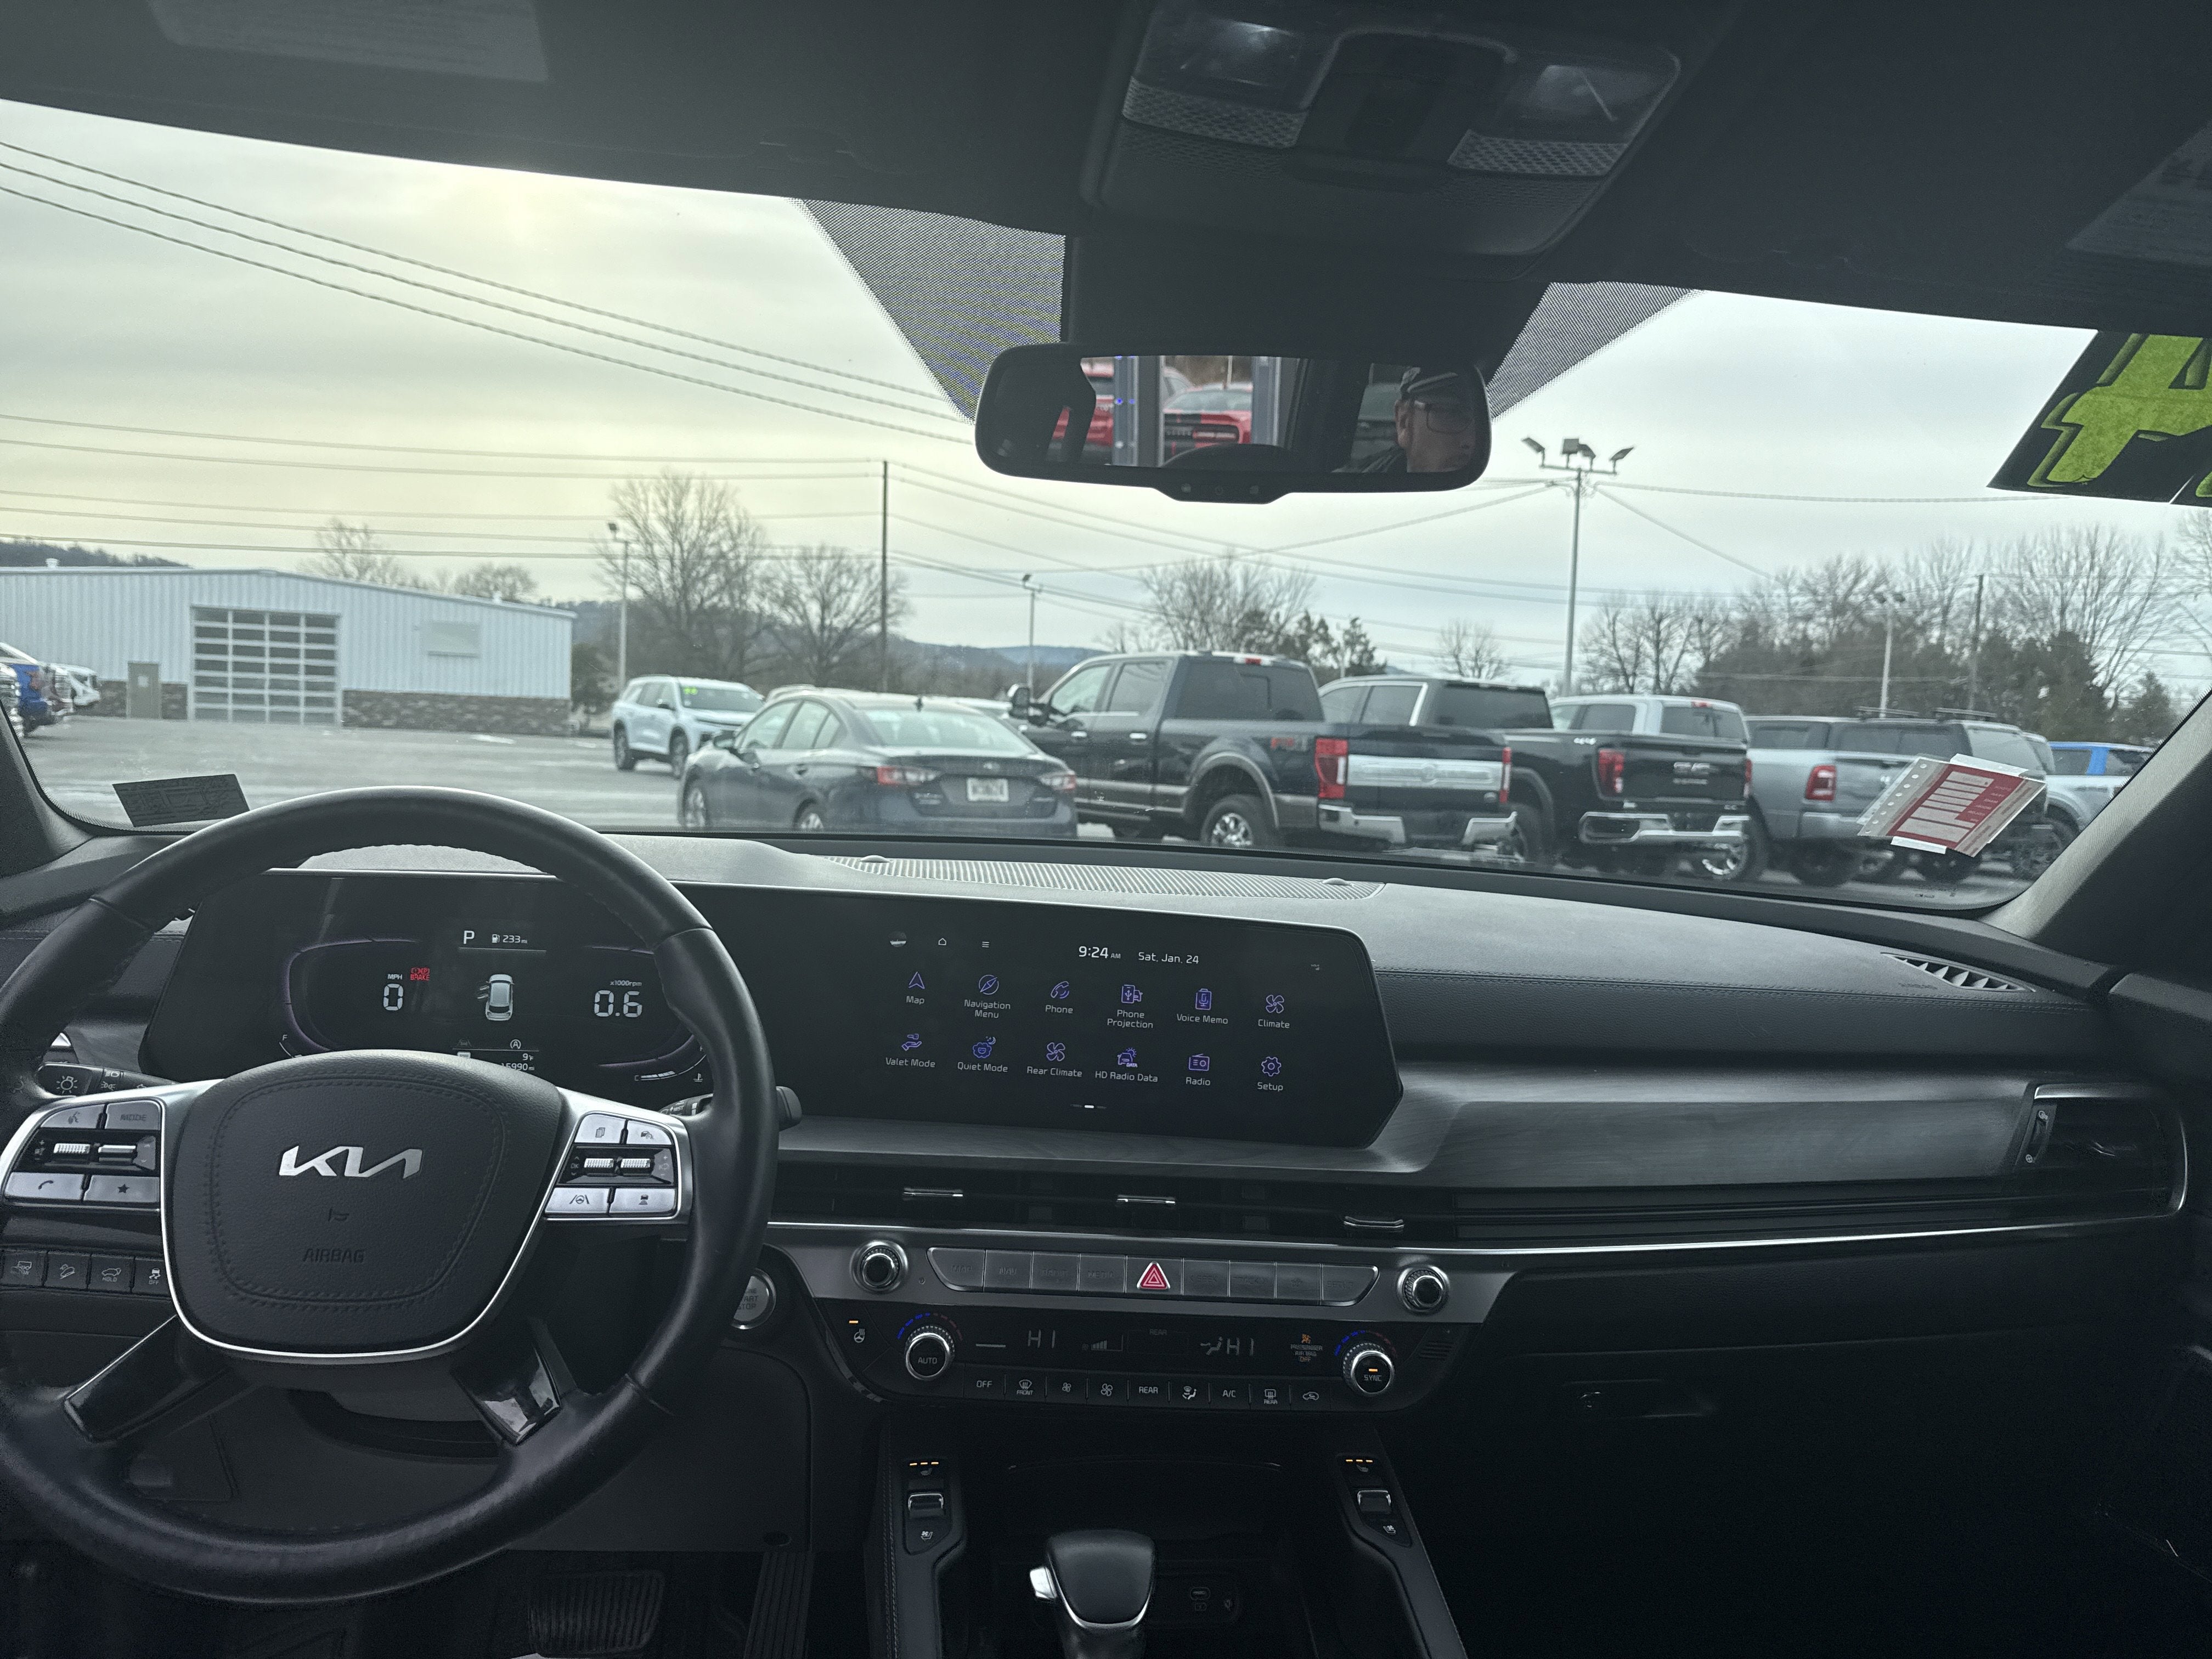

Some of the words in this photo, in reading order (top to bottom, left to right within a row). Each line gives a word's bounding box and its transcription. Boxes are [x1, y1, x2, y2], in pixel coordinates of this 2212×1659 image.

[463, 930, 475, 944] P
[1078, 946, 1109, 959] 9:24
[1161, 953, 1183, 964] Jan.
[1186, 955, 1199, 964] 24
[383, 983, 404, 1011] 0
[906, 996, 925, 1005] Map
[594, 990, 643, 1018] 0.6
[964, 999, 1011, 1010] Navigation
[1045, 1005, 1073, 1014] Phone
[974, 1010, 999, 1019] Menu
[1117, 1009, 1145, 1019] Phone
[1176, 1013, 1200, 1024] Voice
[1201, 1015, 1228, 1025] Memo
[1107, 1018, 1154, 1029] Projection
[1258, 1019, 1290, 1029] Climate
[885, 1057, 909, 1066] Valet
[911, 1059, 935, 1068] Mode
[957, 1062, 981, 1071] Quiet
[984, 1063, 1008, 1073] Mode
[1026, 1066, 1048, 1076] Rear
[1050, 1067, 1082, 1077] Climate
[1095, 1070, 1108, 1080] HD
[1109, 1071, 1135, 1081] Radio
[1137, 1073, 1159, 1083] Data
[1186, 1077, 1211, 1086] Radio
[1257, 1082, 1284, 1092] Setup
[302, 1248, 364, 1263] AIRBAG
[976, 1380, 992, 1388] OFF
[1222, 1390, 1236, 1398] A/C
